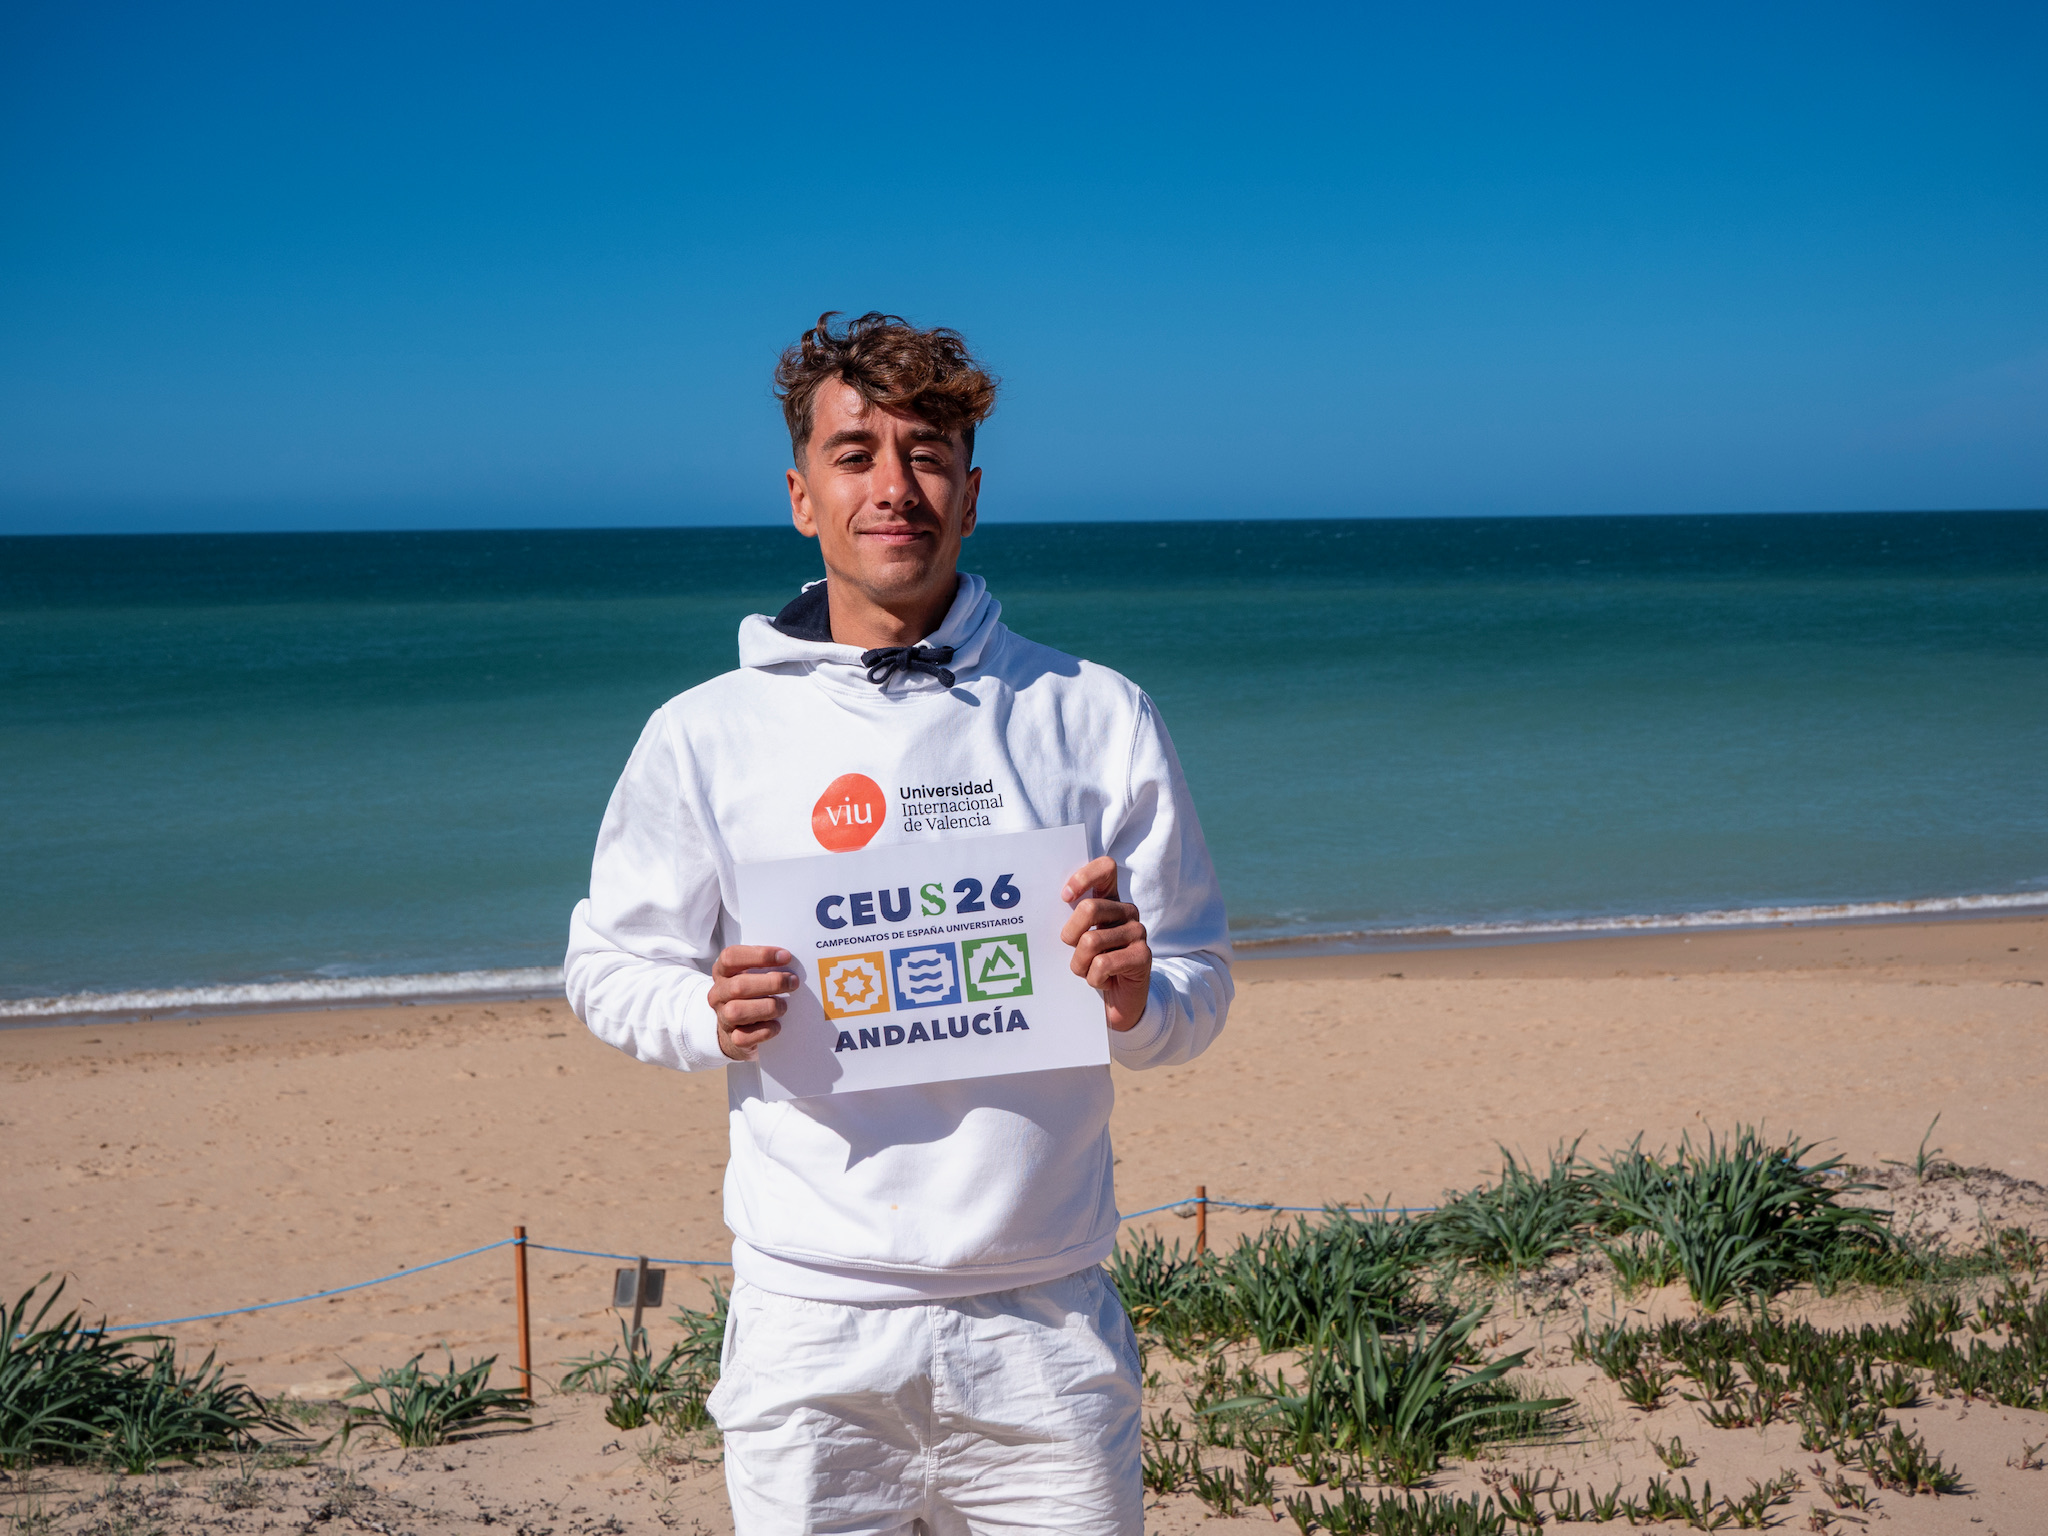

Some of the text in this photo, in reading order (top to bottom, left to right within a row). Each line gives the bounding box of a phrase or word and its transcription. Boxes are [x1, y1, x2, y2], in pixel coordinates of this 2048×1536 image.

[900, 779, 994, 800] Universidad
[825, 796, 873, 827] viu
[902, 794, 1004, 817] Internacional
[904, 813, 991, 832] de Valencia
[815, 915, 1025, 949] CAMPEONATOS DE ESPAÑA UNIVERSITARIOS
[834, 1006, 1030, 1053] ANDALUCÍA
